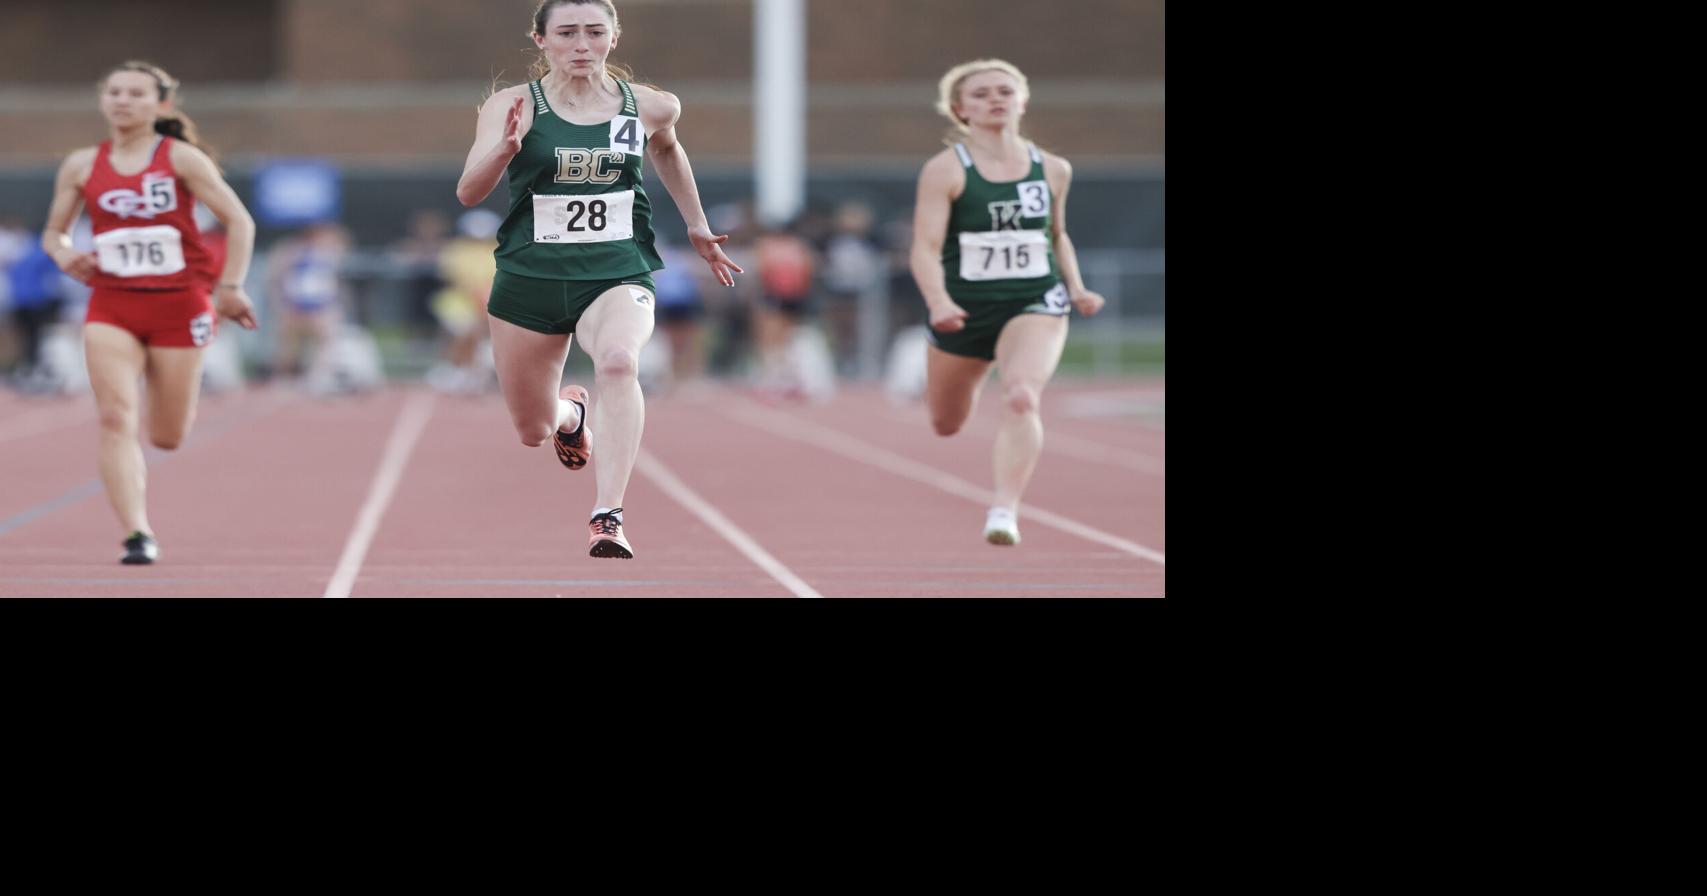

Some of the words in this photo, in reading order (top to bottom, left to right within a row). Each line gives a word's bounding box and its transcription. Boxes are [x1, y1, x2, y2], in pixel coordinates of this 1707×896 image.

[614, 119, 639, 152] 4
[554, 147, 625, 184] BC
[151, 182, 170, 209] 5
[1026, 185, 1045, 213] 3
[566, 200, 607, 232] 28
[117, 242, 165, 266] 176
[979, 244, 1030, 271] 715
